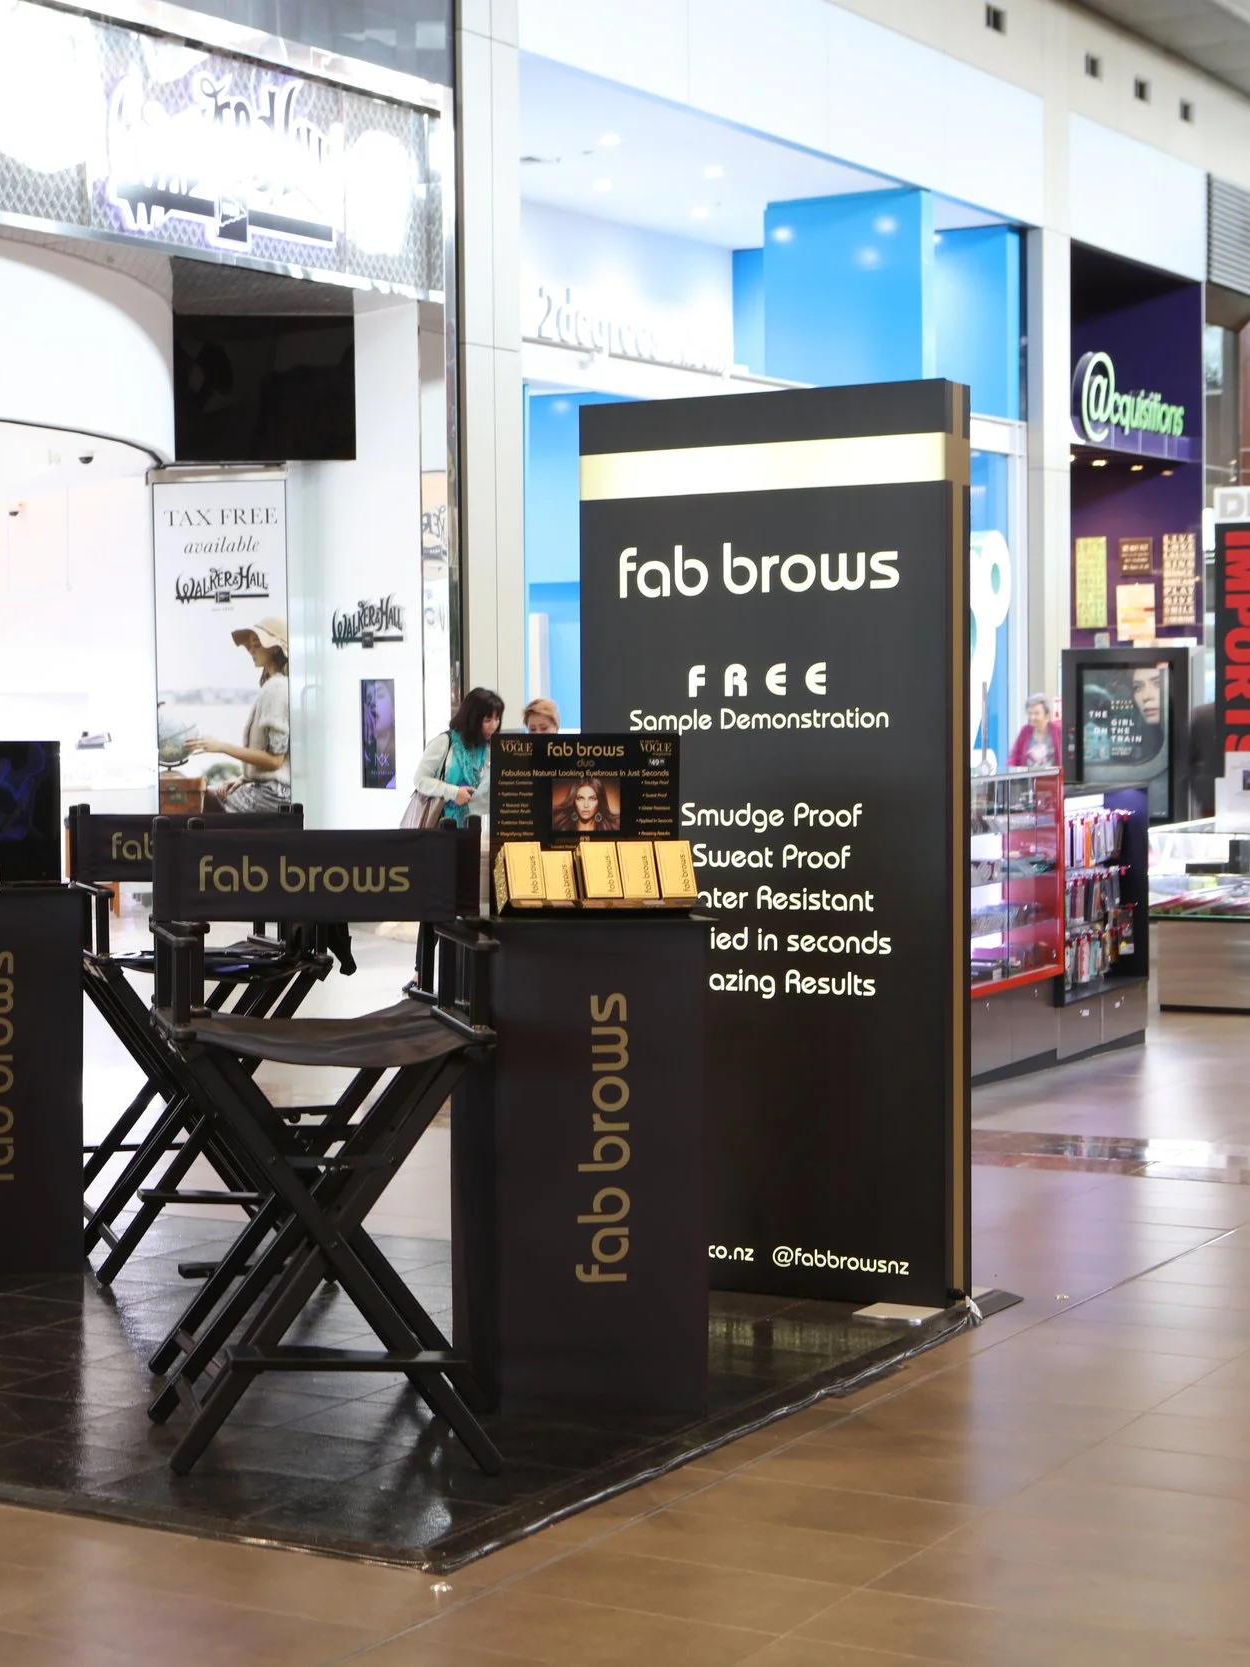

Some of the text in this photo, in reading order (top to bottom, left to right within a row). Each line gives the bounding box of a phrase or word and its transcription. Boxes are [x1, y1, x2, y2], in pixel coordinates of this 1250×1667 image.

[164, 508, 277, 526] TAX FREE
[184, 535, 259, 554] available
[620, 542, 900, 598] fab brows
[689, 662, 826, 697] FREE
[630, 708, 889, 735] Sample Demonstration
[501, 743, 533, 752] VOGUE
[547, 741, 624, 757] fab brows
[640, 743, 672, 752] VOGUE
[1111, 735, 1142, 743] TRAIN
[501, 769, 531, 777] Fabulous
[558, 770, 584, 778] Looking
[586, 769, 618, 777] Eyebrows
[641, 769, 669, 777] Seconds
[577, 758, 595, 767] duo
[681, 803, 862, 833] Smudge Proof
[693, 844, 850, 869] Sweat Proof
[199, 855, 410, 893] fab brows
[564, 888, 572, 899] ab
[698, 885, 874, 911] ater Resistant
[758, 928, 778, 950] in
[787, 930, 892, 954] seconds
[709, 969, 876, 999] azing Results
[576, 993, 630, 1283] fab brows
[709, 1245, 909, 1275] co.nz @fabbrowsnz
